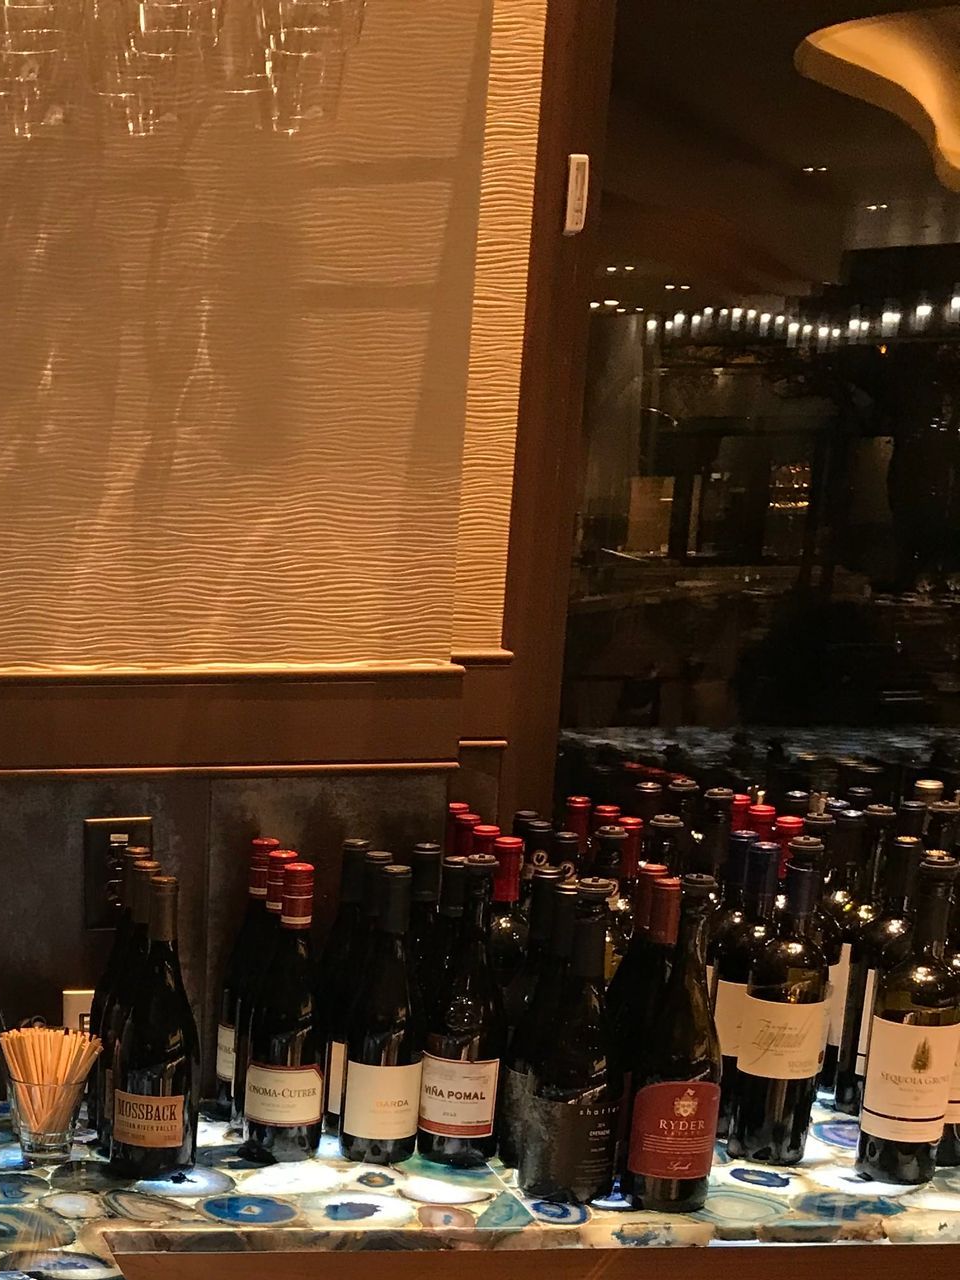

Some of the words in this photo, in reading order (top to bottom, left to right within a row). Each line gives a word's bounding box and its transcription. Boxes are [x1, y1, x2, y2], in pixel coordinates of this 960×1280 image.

[424, 1083, 445, 1099] VIÑA
[447, 1090, 486, 1101] POMAL
[117, 1098, 178, 1122] MOSSBACK
[658, 1118, 706, 1131] RYDER
